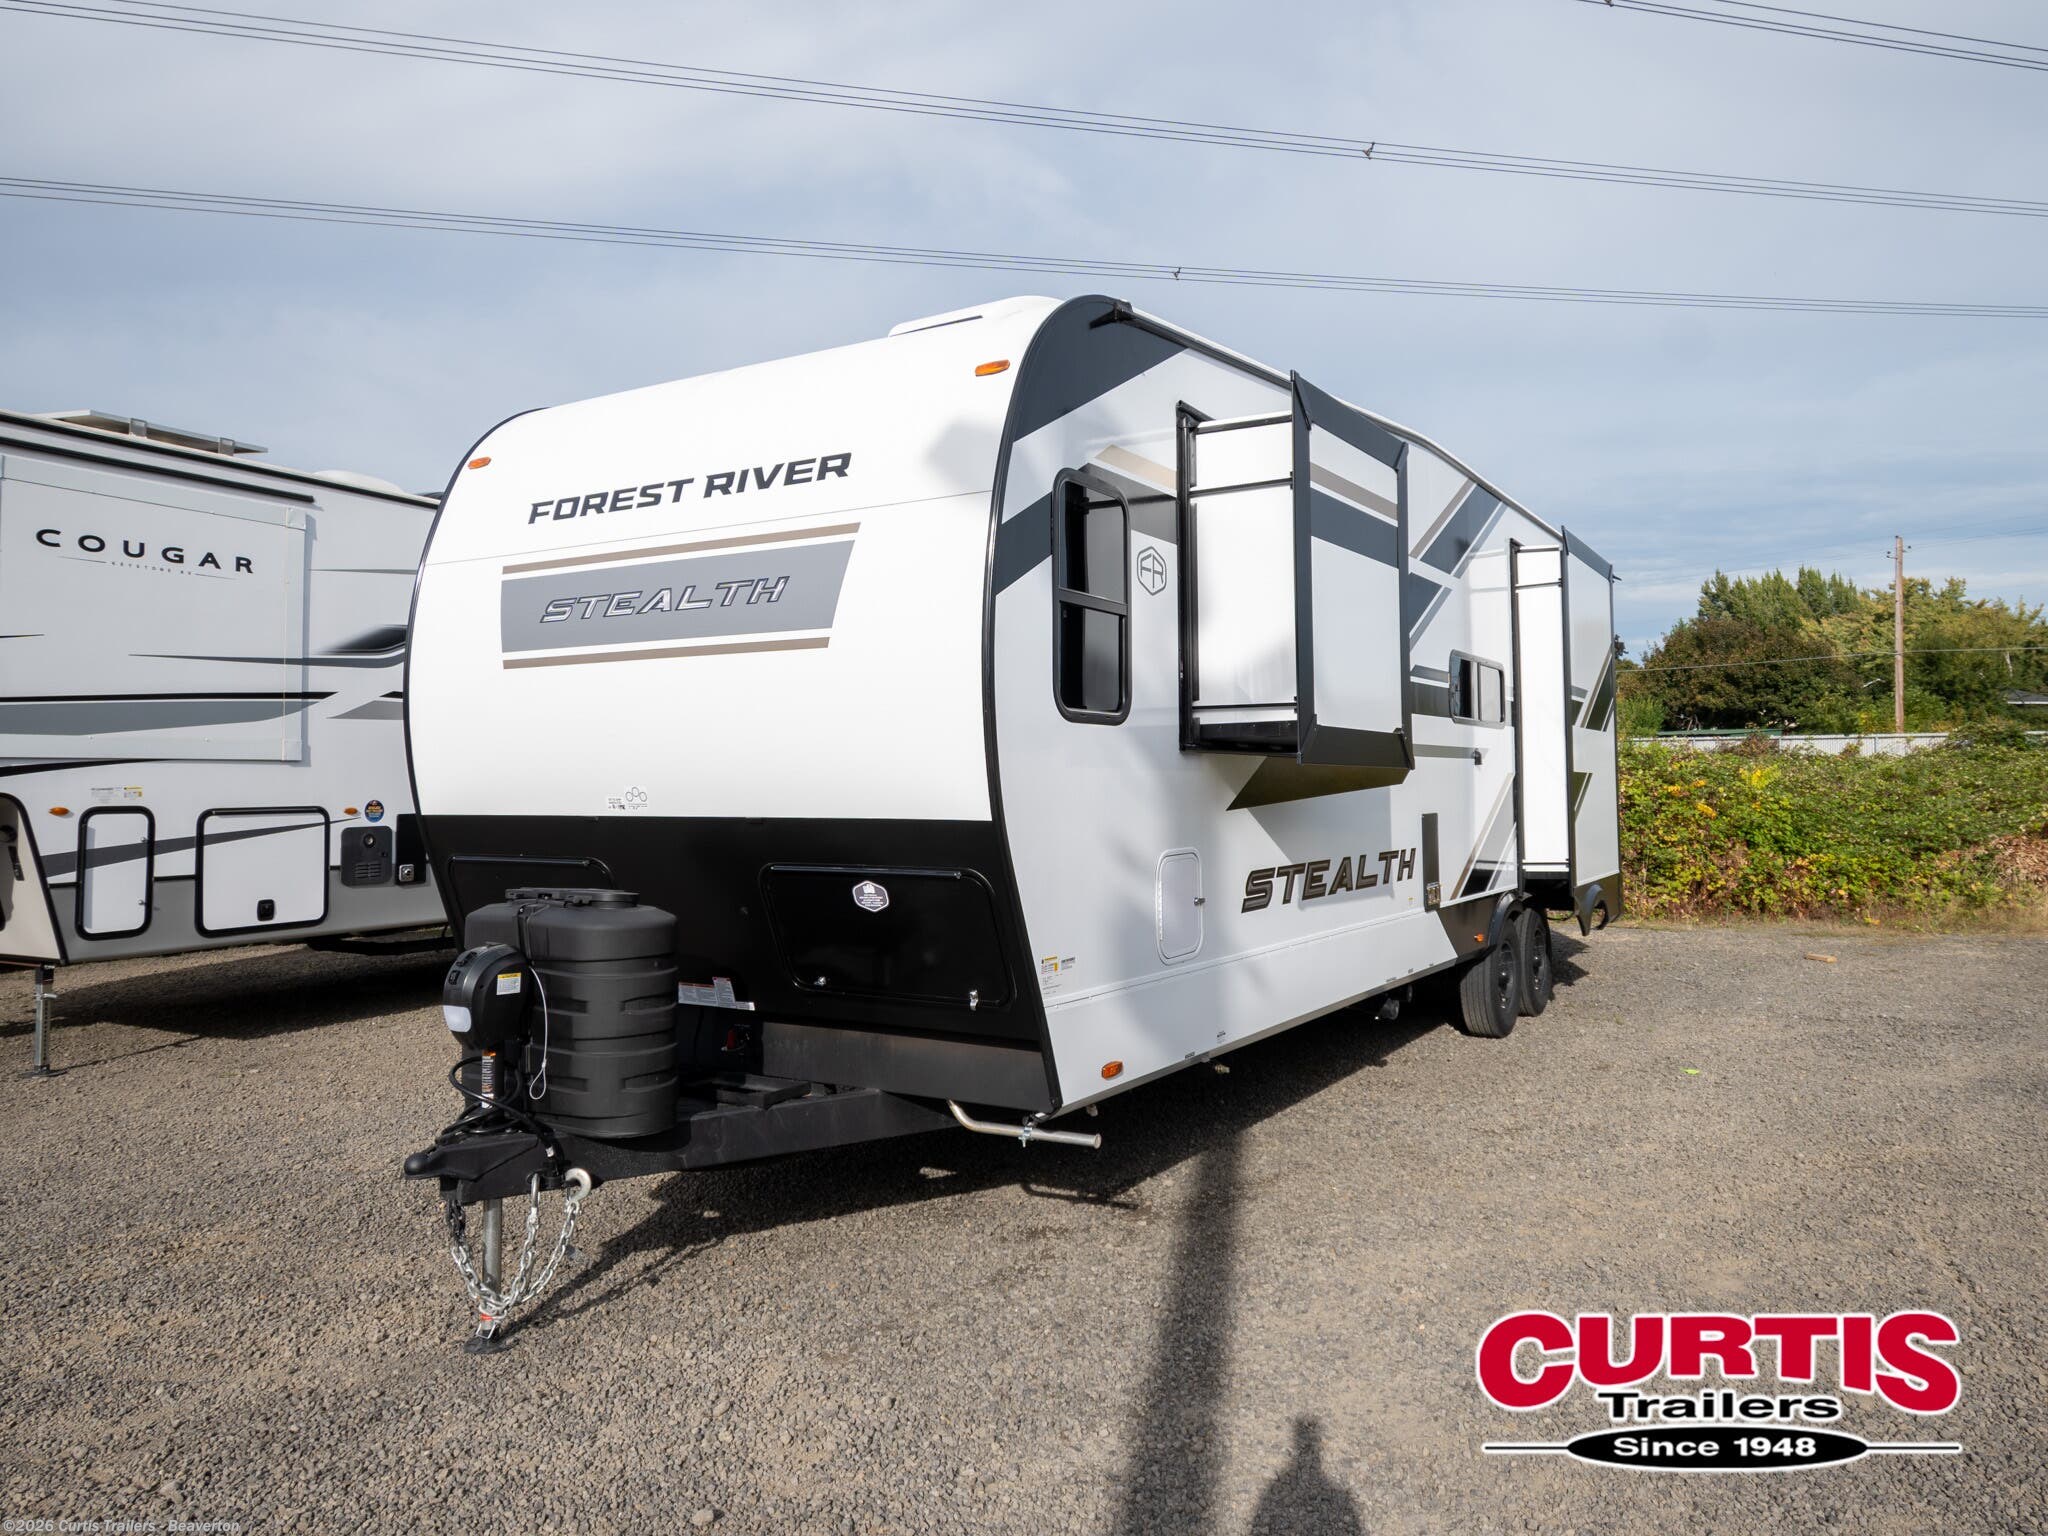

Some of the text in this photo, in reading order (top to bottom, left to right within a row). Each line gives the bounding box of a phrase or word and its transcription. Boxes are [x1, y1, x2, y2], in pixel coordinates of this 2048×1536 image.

[528, 452, 852, 525] FOREST RIVER
[36, 528, 253, 574] COUGAR
[539, 575, 791, 624] STEALTH
[1240, 847, 1417, 914] STEALTH
